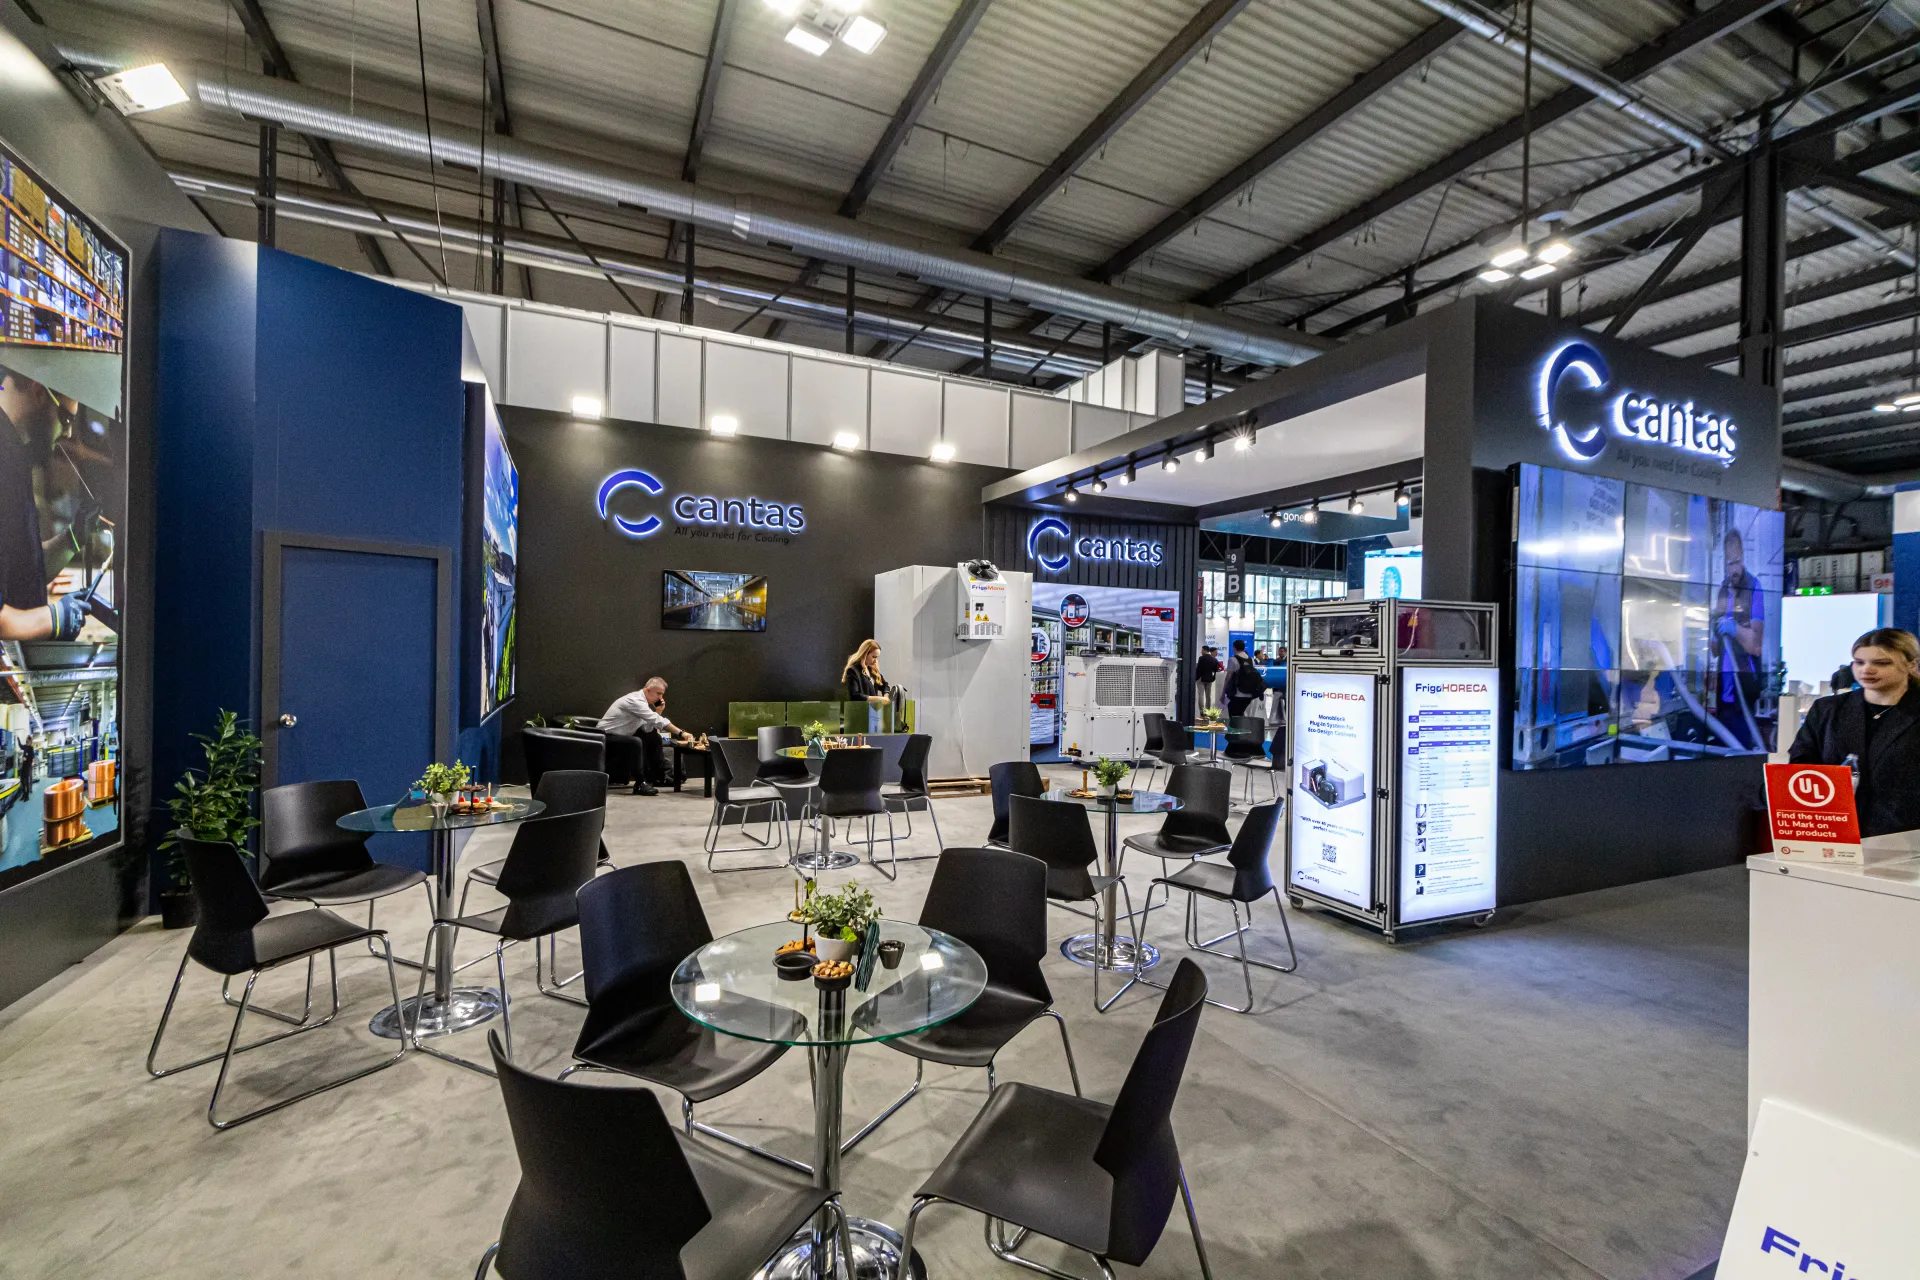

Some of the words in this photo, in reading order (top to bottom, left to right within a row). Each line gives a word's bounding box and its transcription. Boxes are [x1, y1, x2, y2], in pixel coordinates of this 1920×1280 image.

[674, 526, 687, 535] All
[690, 529, 709, 539] you
[711, 531, 735, 541] need
[737, 531, 751, 542] for
[754, 533, 791, 545] Cooling
[1231, 553, 1237, 564] 9
[1228, 574, 1240, 594] B
[1415, 683, 1488, 694] FrigoHORECA
[1301, 690, 1366, 702] FrigoHORECA
[1798, 777, 1825, 800] UL
[1798, 812, 1813, 820] the
[1815, 814, 1848, 822] trusted
[1792, 821, 1815, 829] Mark
[1760, 1226, 1858, 1280] Fri
